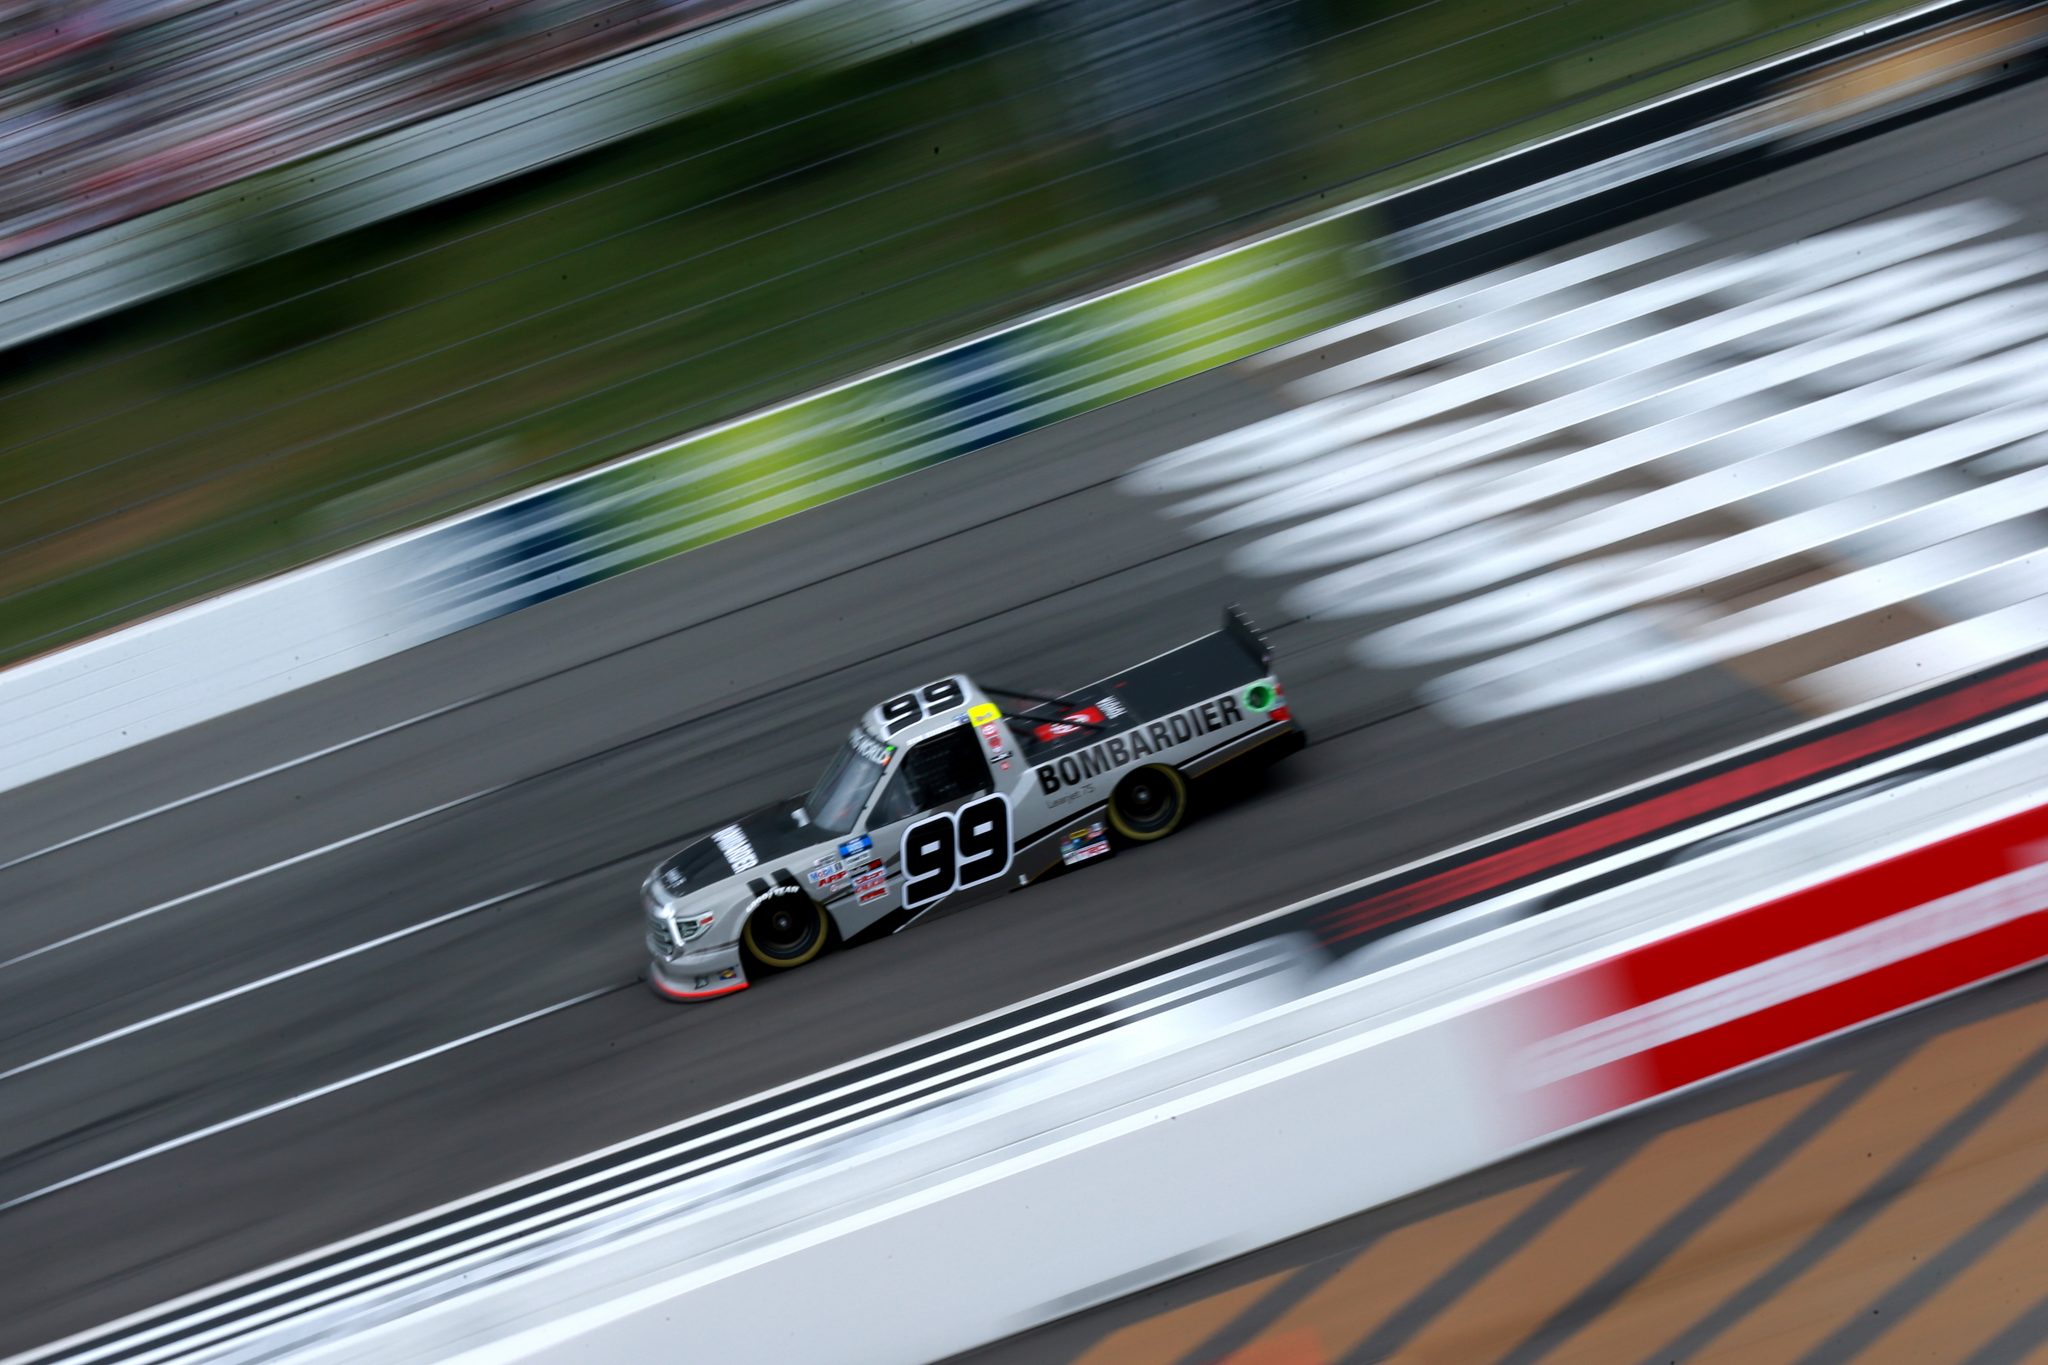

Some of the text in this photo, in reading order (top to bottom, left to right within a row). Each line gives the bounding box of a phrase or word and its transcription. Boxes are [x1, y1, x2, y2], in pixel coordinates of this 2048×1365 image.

[881, 678, 965, 736] 99
[1035, 695, 1244, 795] BOMBARDIER
[903, 795, 1010, 909] 99
